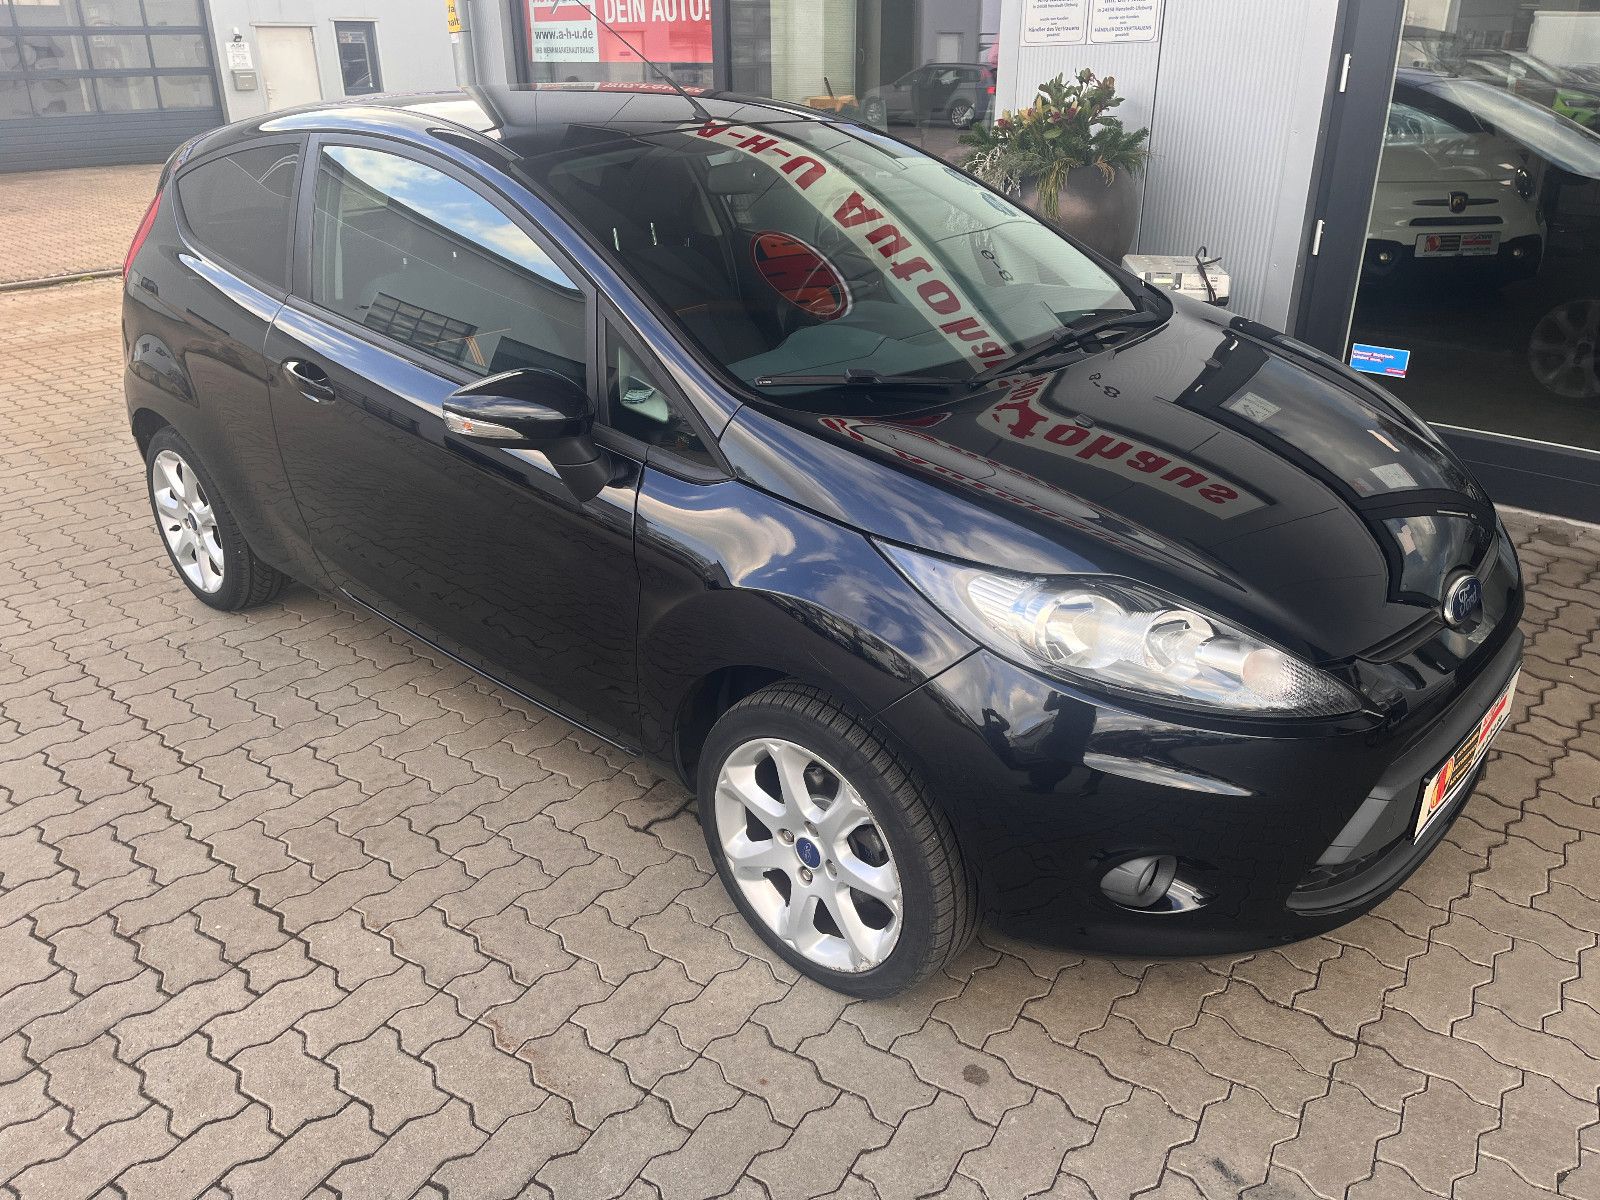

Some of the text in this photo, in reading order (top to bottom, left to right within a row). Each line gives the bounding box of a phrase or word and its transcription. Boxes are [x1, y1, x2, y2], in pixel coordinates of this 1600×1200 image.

[604, 0, 711, 23] DEIN AUTO!
[535, 28, 594, 40] www.a-h-u.de
[1458, 583, 1478, 617] Ford
